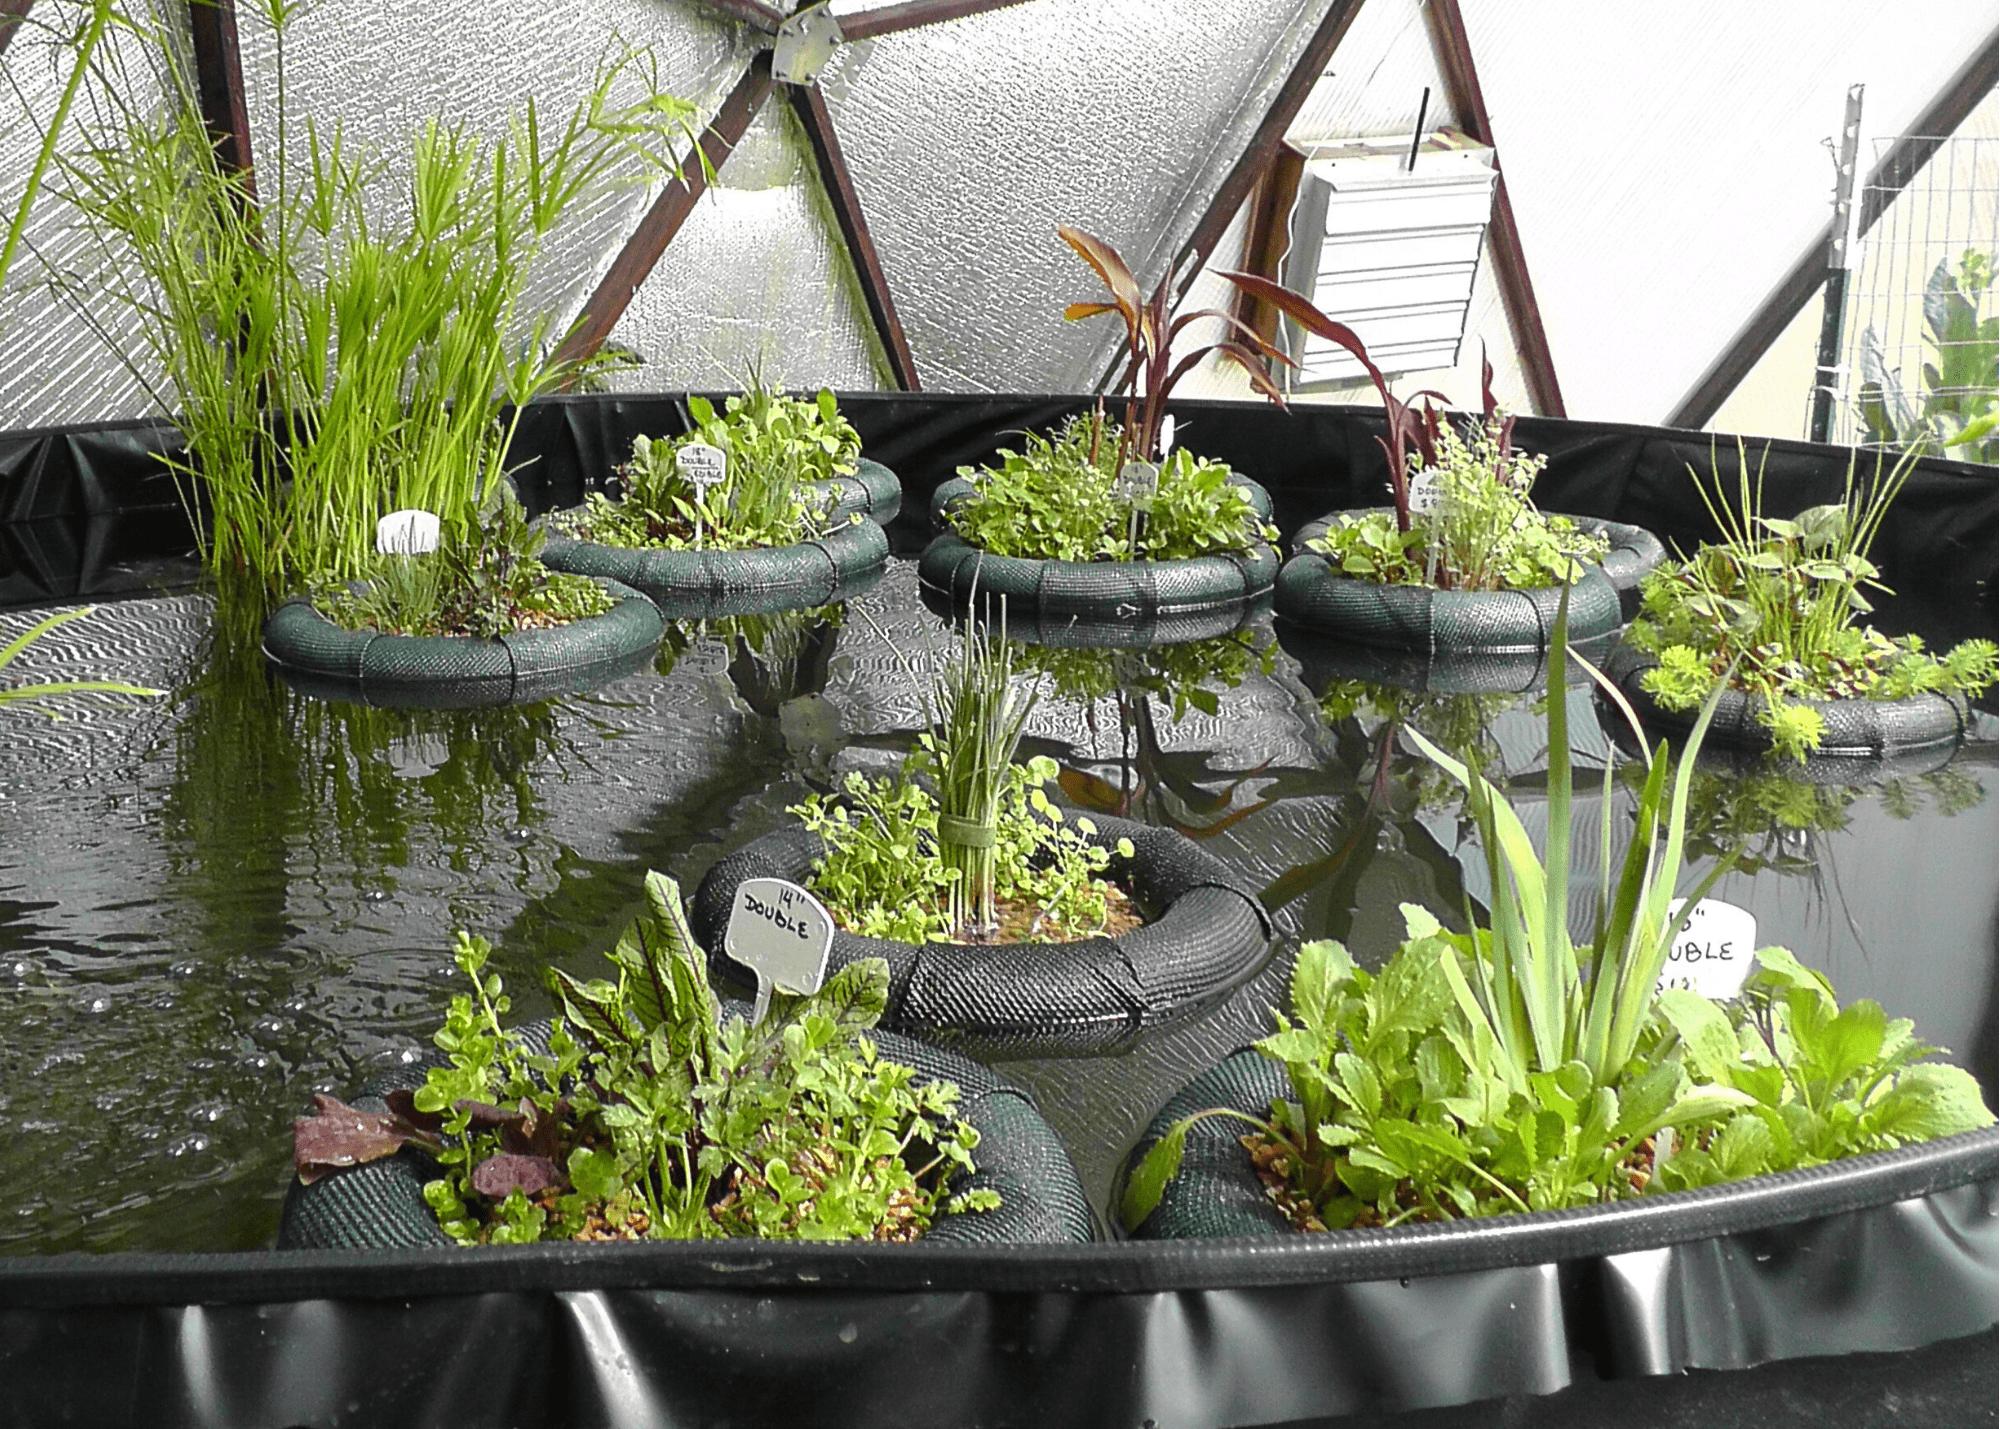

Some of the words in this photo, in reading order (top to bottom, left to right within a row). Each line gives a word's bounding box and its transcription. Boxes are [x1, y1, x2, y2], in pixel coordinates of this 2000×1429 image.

[779, 888, 806, 909] 14"
[744, 892, 809, 940] DOUBLE
[1669, 941, 1734, 963] UBLE
